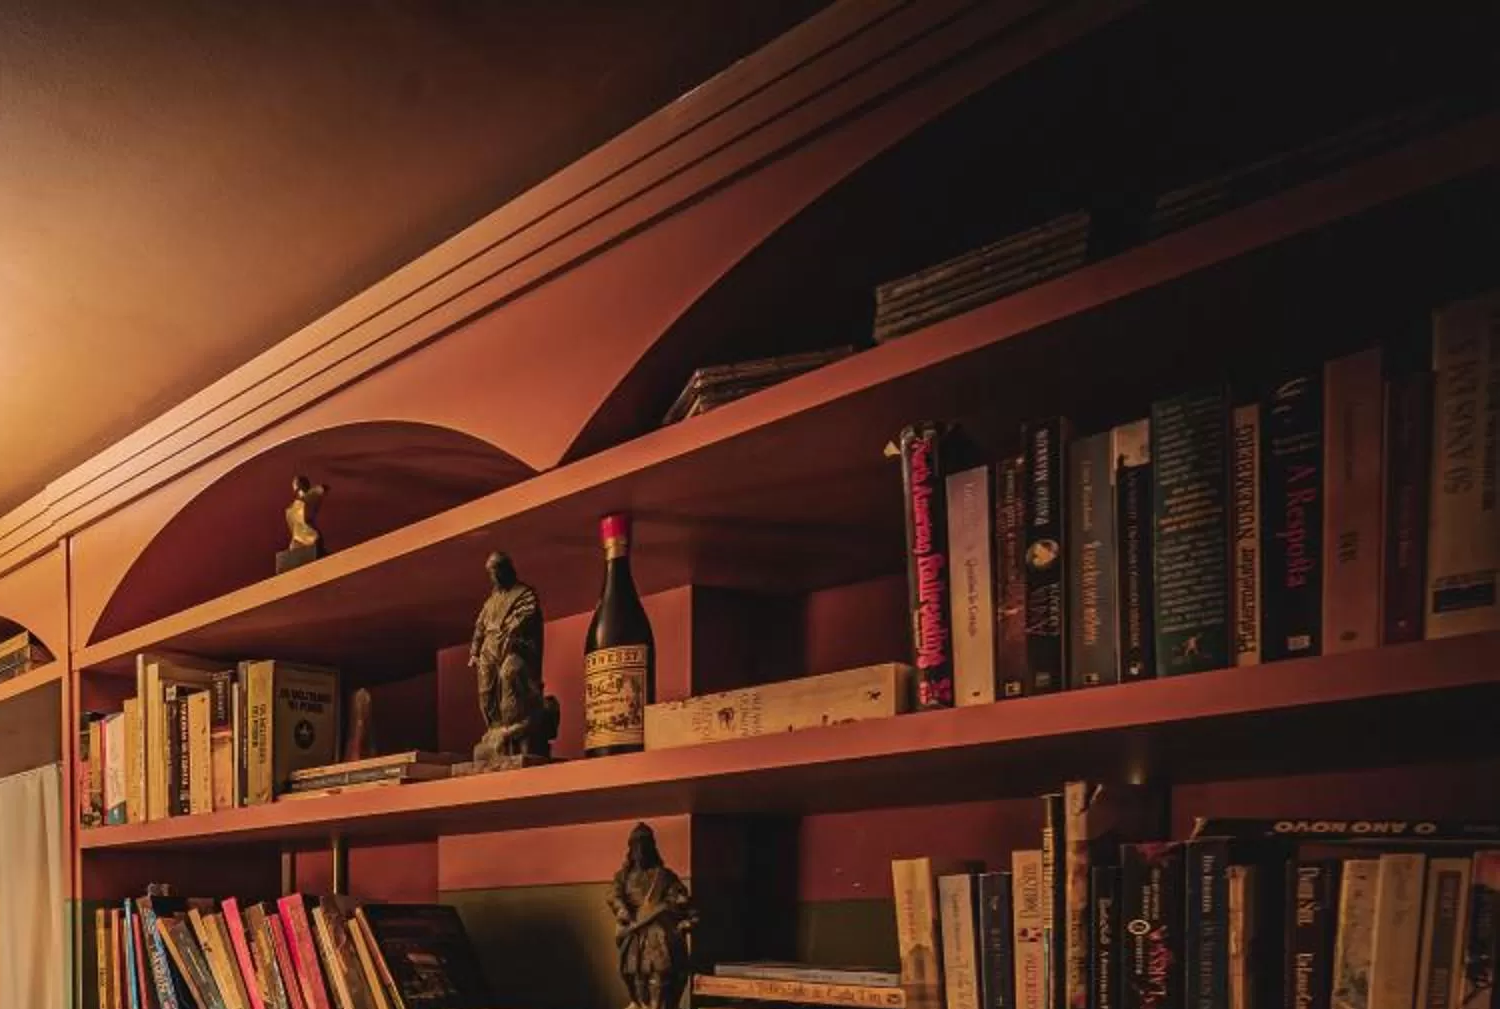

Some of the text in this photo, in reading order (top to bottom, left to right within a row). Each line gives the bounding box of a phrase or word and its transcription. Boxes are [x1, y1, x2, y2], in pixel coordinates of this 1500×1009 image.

[1272, 820, 1437, 834] O ANO NOVO
